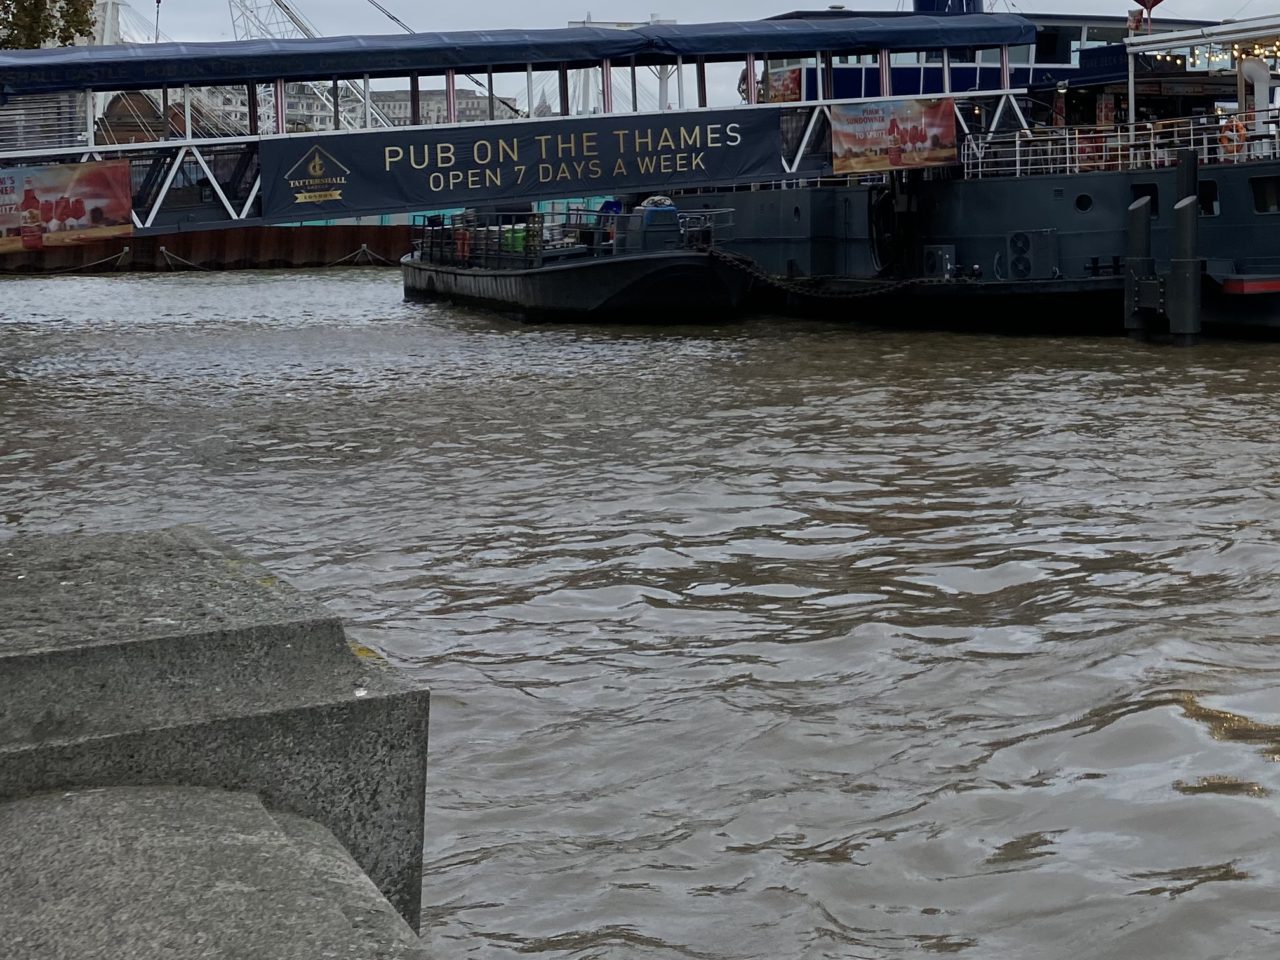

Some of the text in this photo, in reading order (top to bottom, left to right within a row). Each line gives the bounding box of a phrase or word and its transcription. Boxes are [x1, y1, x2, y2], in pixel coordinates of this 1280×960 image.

[384, 123, 741, 171] PUB ON THE THAMES
[289, 176, 346, 187] TATTERSHALL
[429, 152, 705, 192] OPEN 7 DAYS A WEEK
